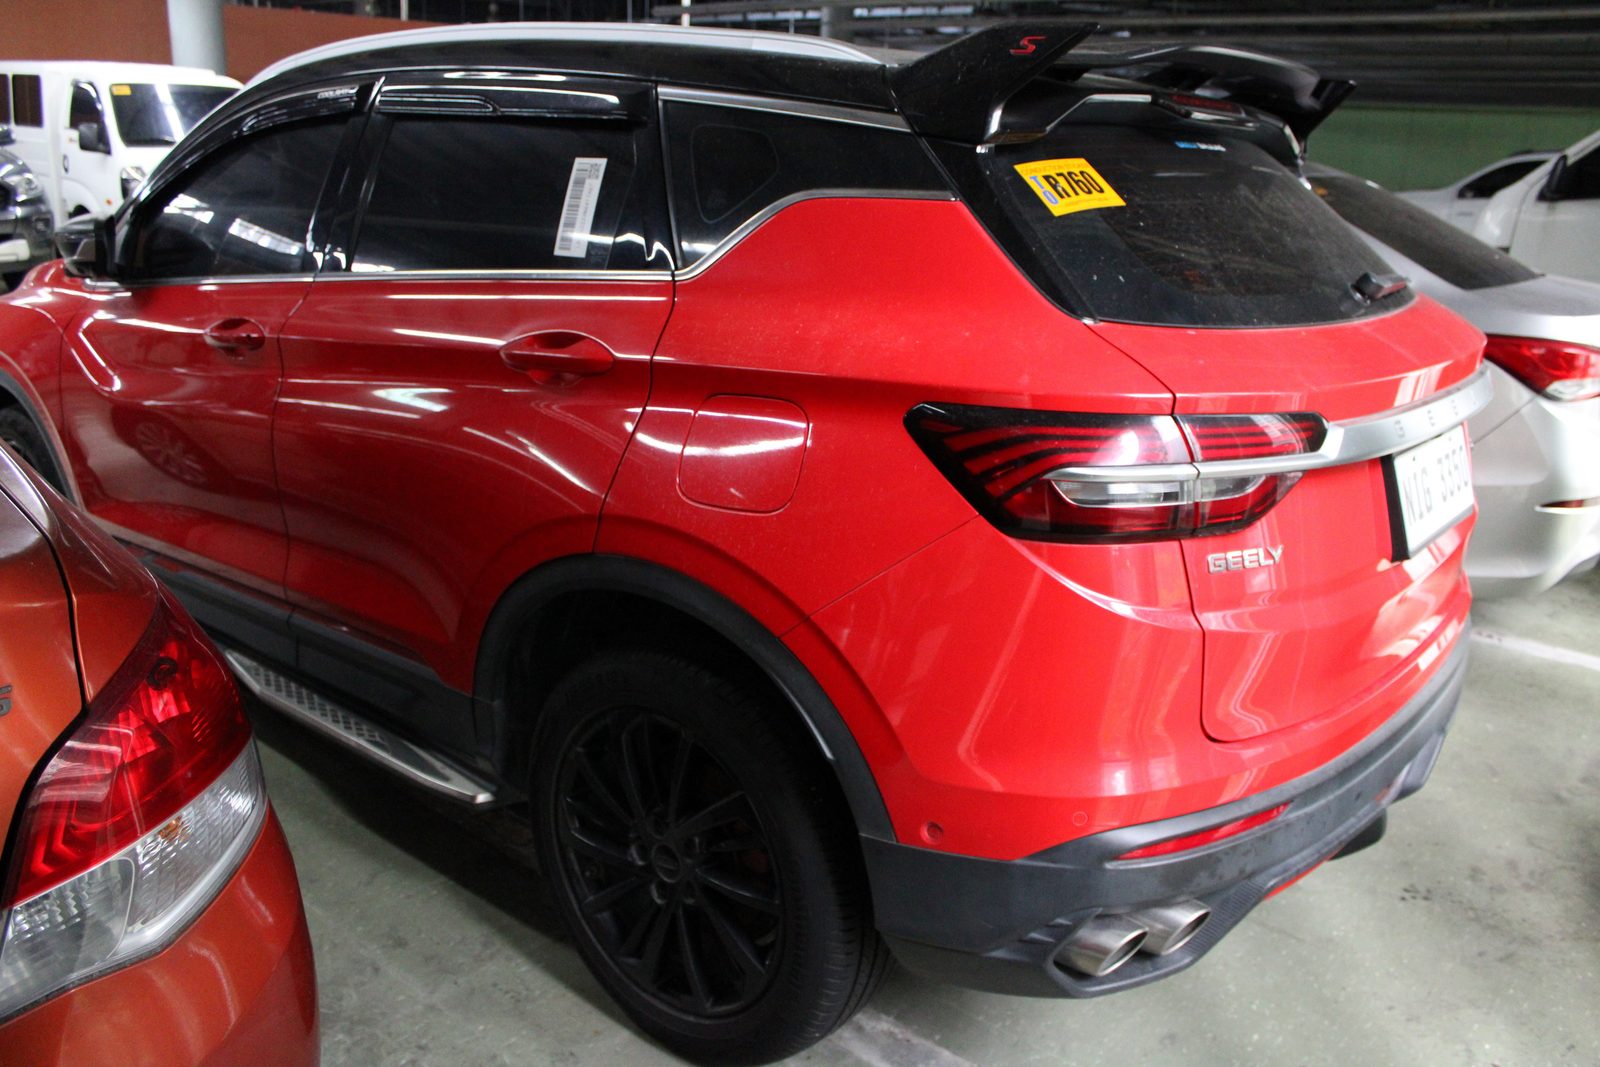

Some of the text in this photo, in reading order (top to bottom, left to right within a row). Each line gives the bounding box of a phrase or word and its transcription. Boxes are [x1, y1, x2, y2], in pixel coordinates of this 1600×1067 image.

[1009, 35, 1047, 55] S
[1042, 170, 1105, 200] R760
[1207, 544, 1284, 574] GEELY
